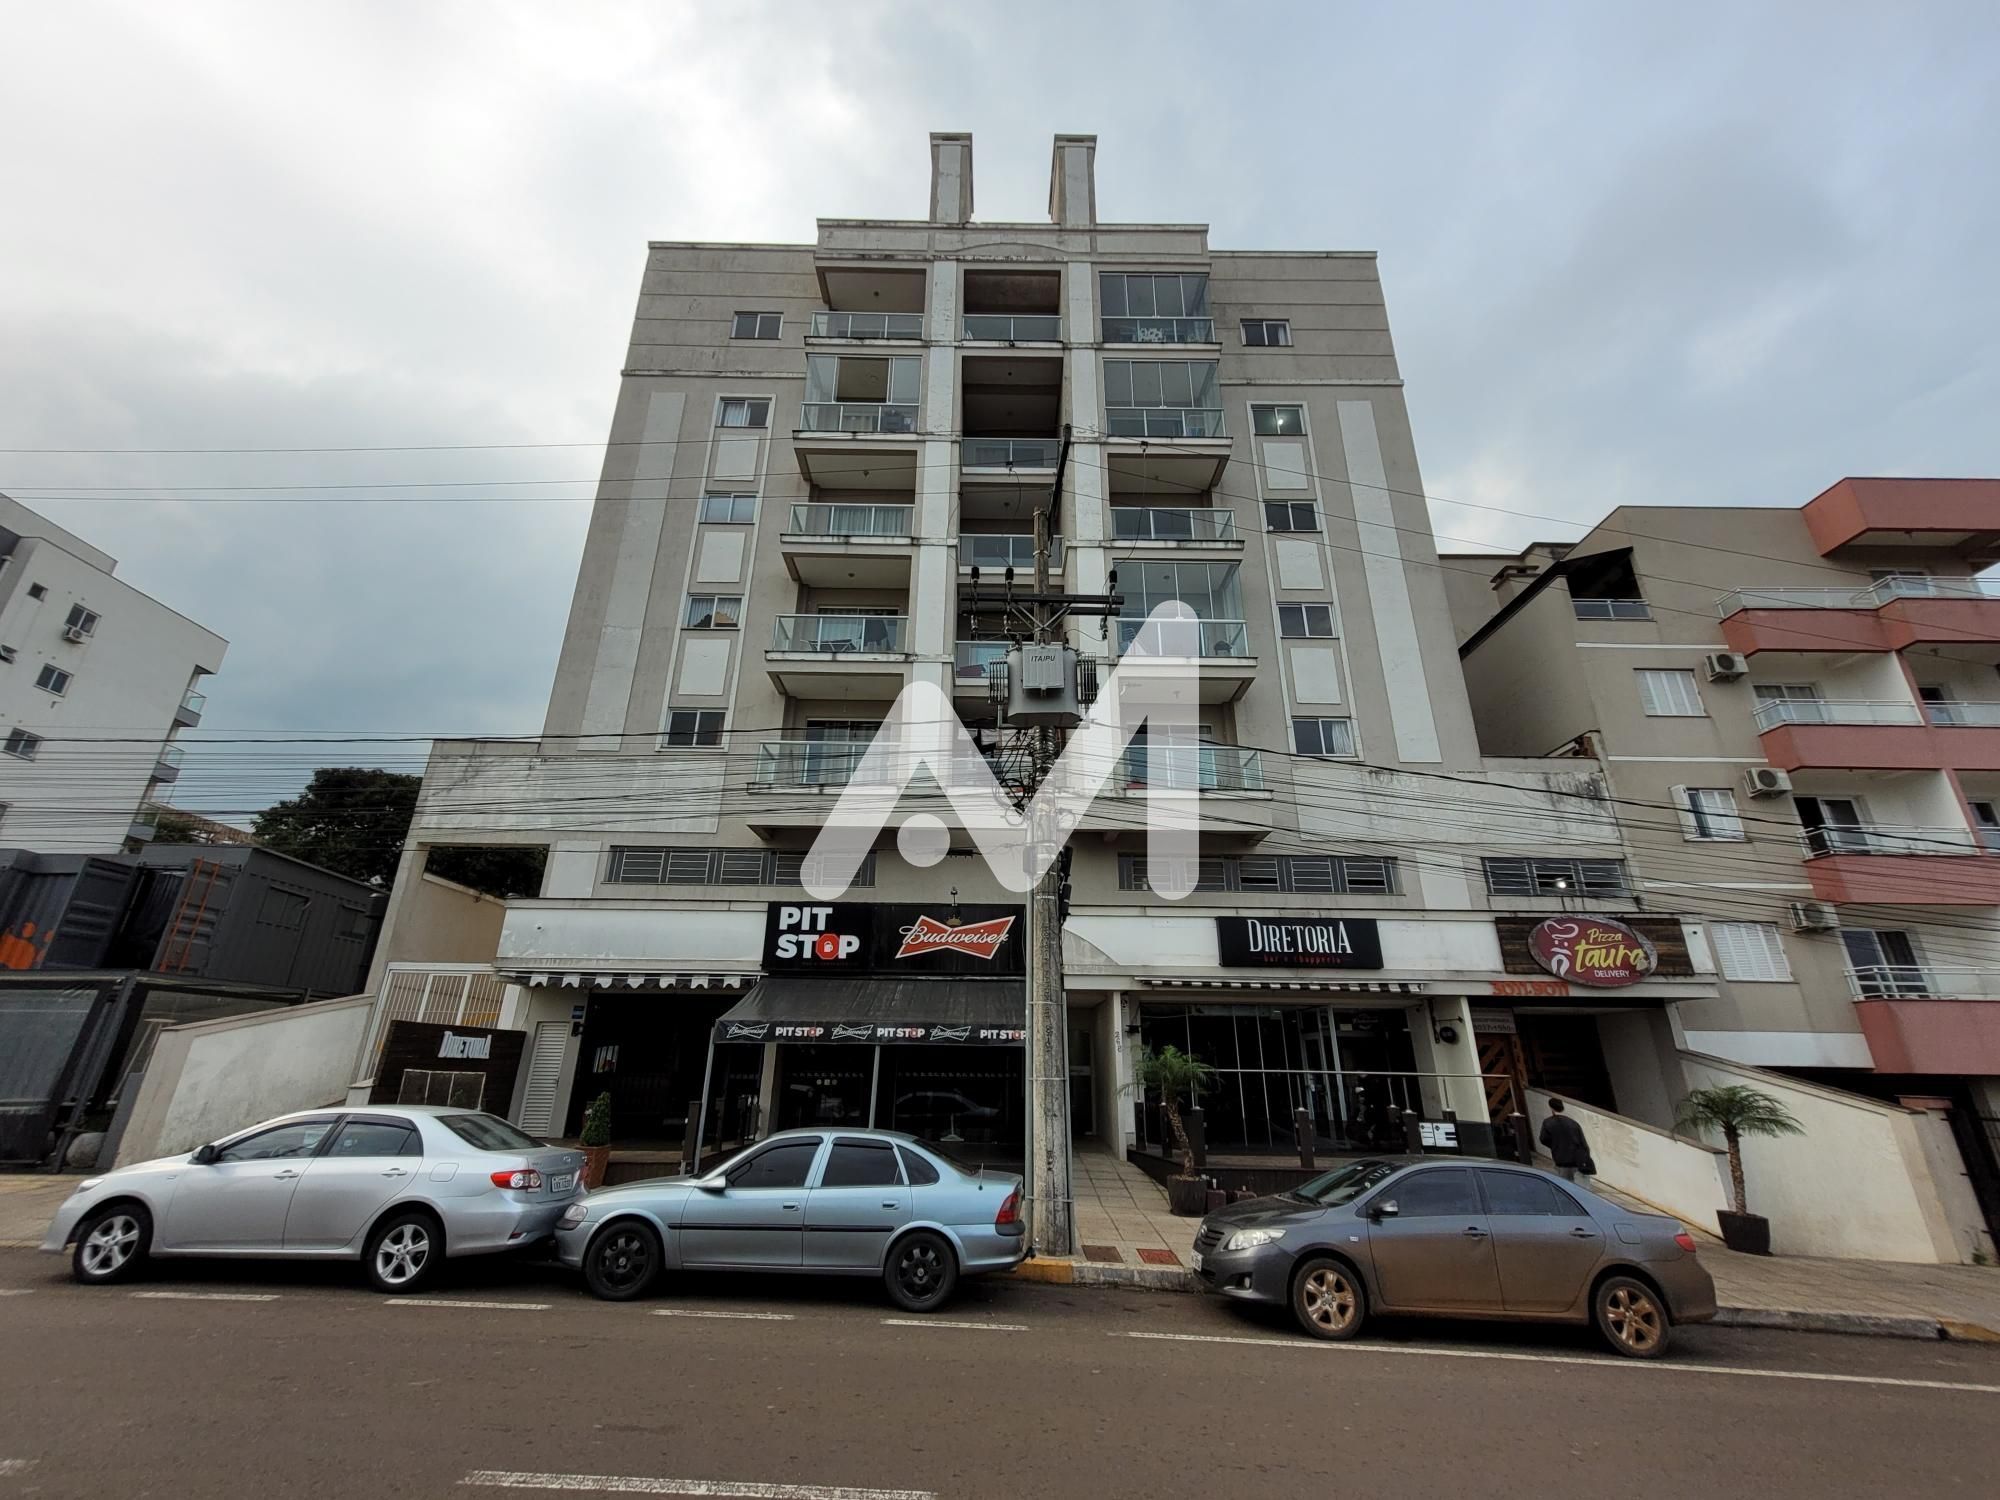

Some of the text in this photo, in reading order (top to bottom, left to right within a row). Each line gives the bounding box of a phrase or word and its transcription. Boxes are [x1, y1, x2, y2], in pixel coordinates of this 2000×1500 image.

[779, 906, 833, 930] PIT
[898, 925, 1010, 945] Budweiser
[1247, 919, 1353, 954] DIRETORIA
[1586, 928, 1623, 944] Pizza
[775, 933, 860, 959] STOP
[1594, 969, 1630, 978] DELIVERY
[775, 1025, 825, 1038] PIT STOP
[876, 1027, 926, 1039] PIT STOP
[980, 1029, 999, 1039] PIT
